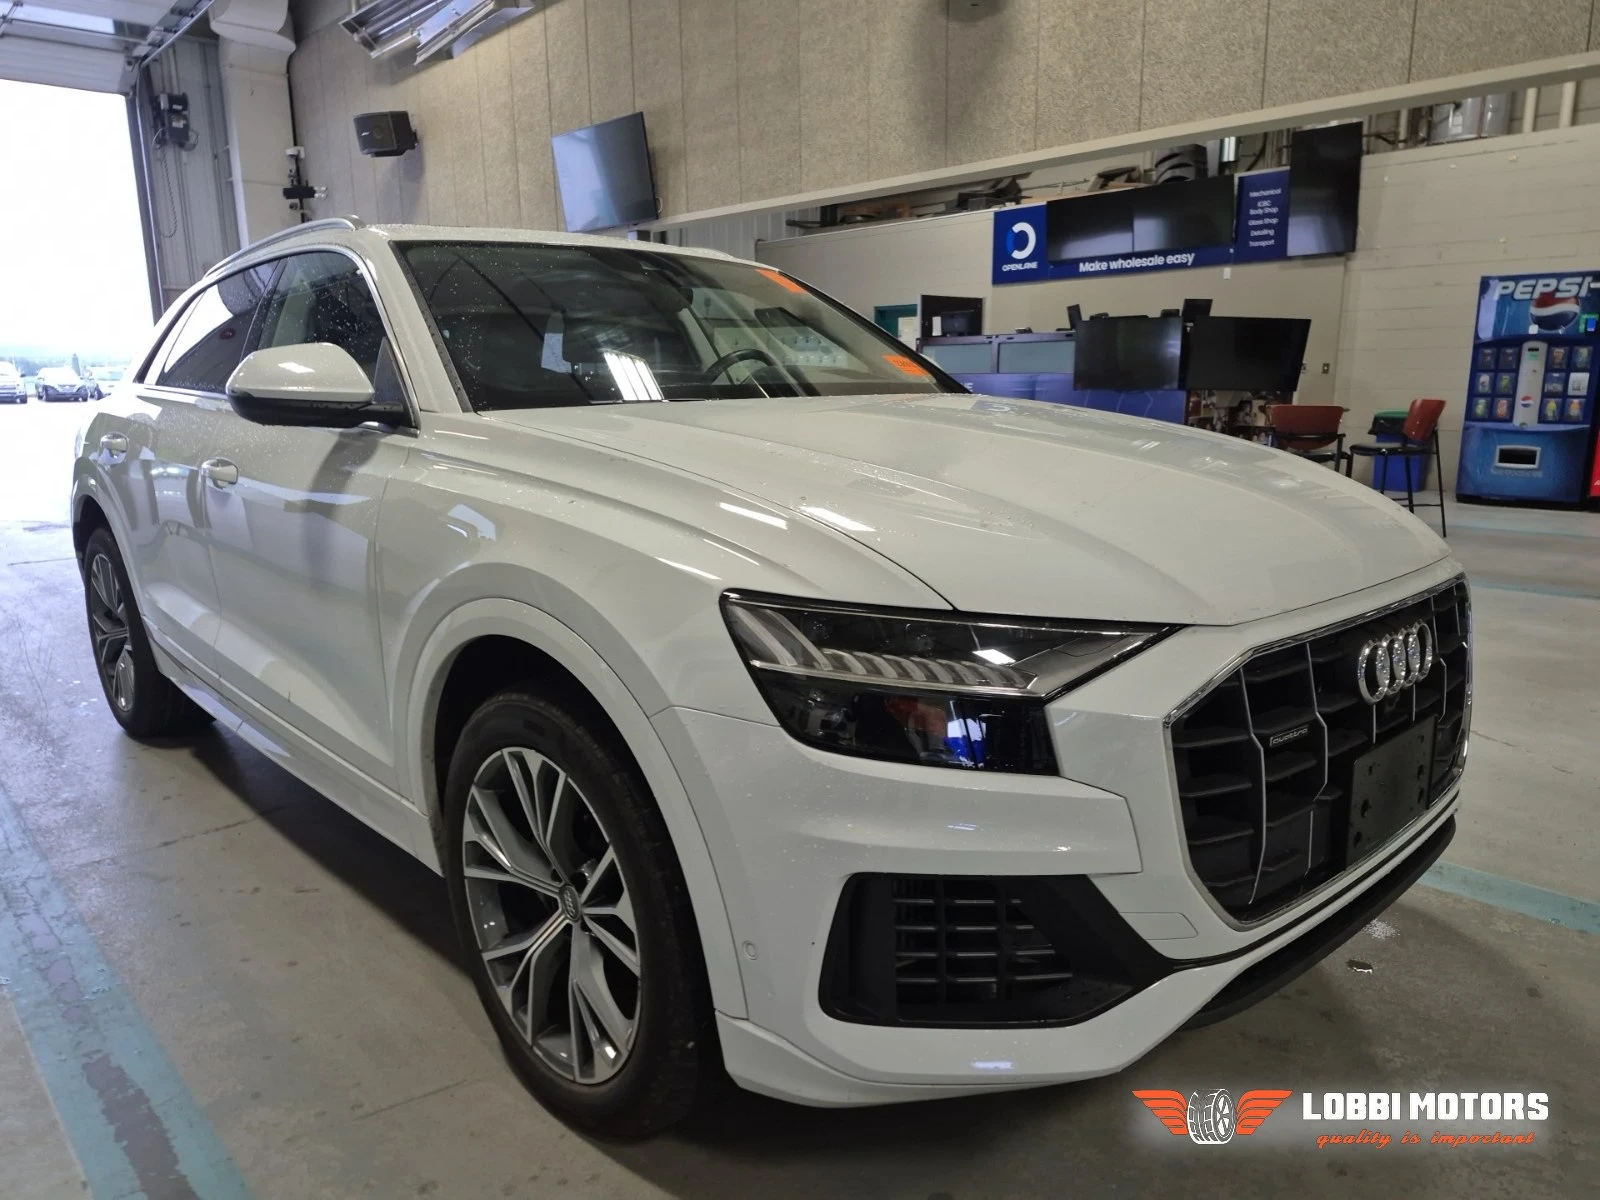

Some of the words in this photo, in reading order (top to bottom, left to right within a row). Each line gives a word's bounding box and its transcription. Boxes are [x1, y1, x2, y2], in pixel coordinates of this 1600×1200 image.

[1002, 261, 1038, 272] OPENLANE
[1079, 261, 1108, 273] Make
[1109, 255, 1165, 270] wholesale
[1166, 252, 1196, 266] easy
[1493, 276, 1593, 301] PEPSI
[1272, 728, 1308, 744] quattro
